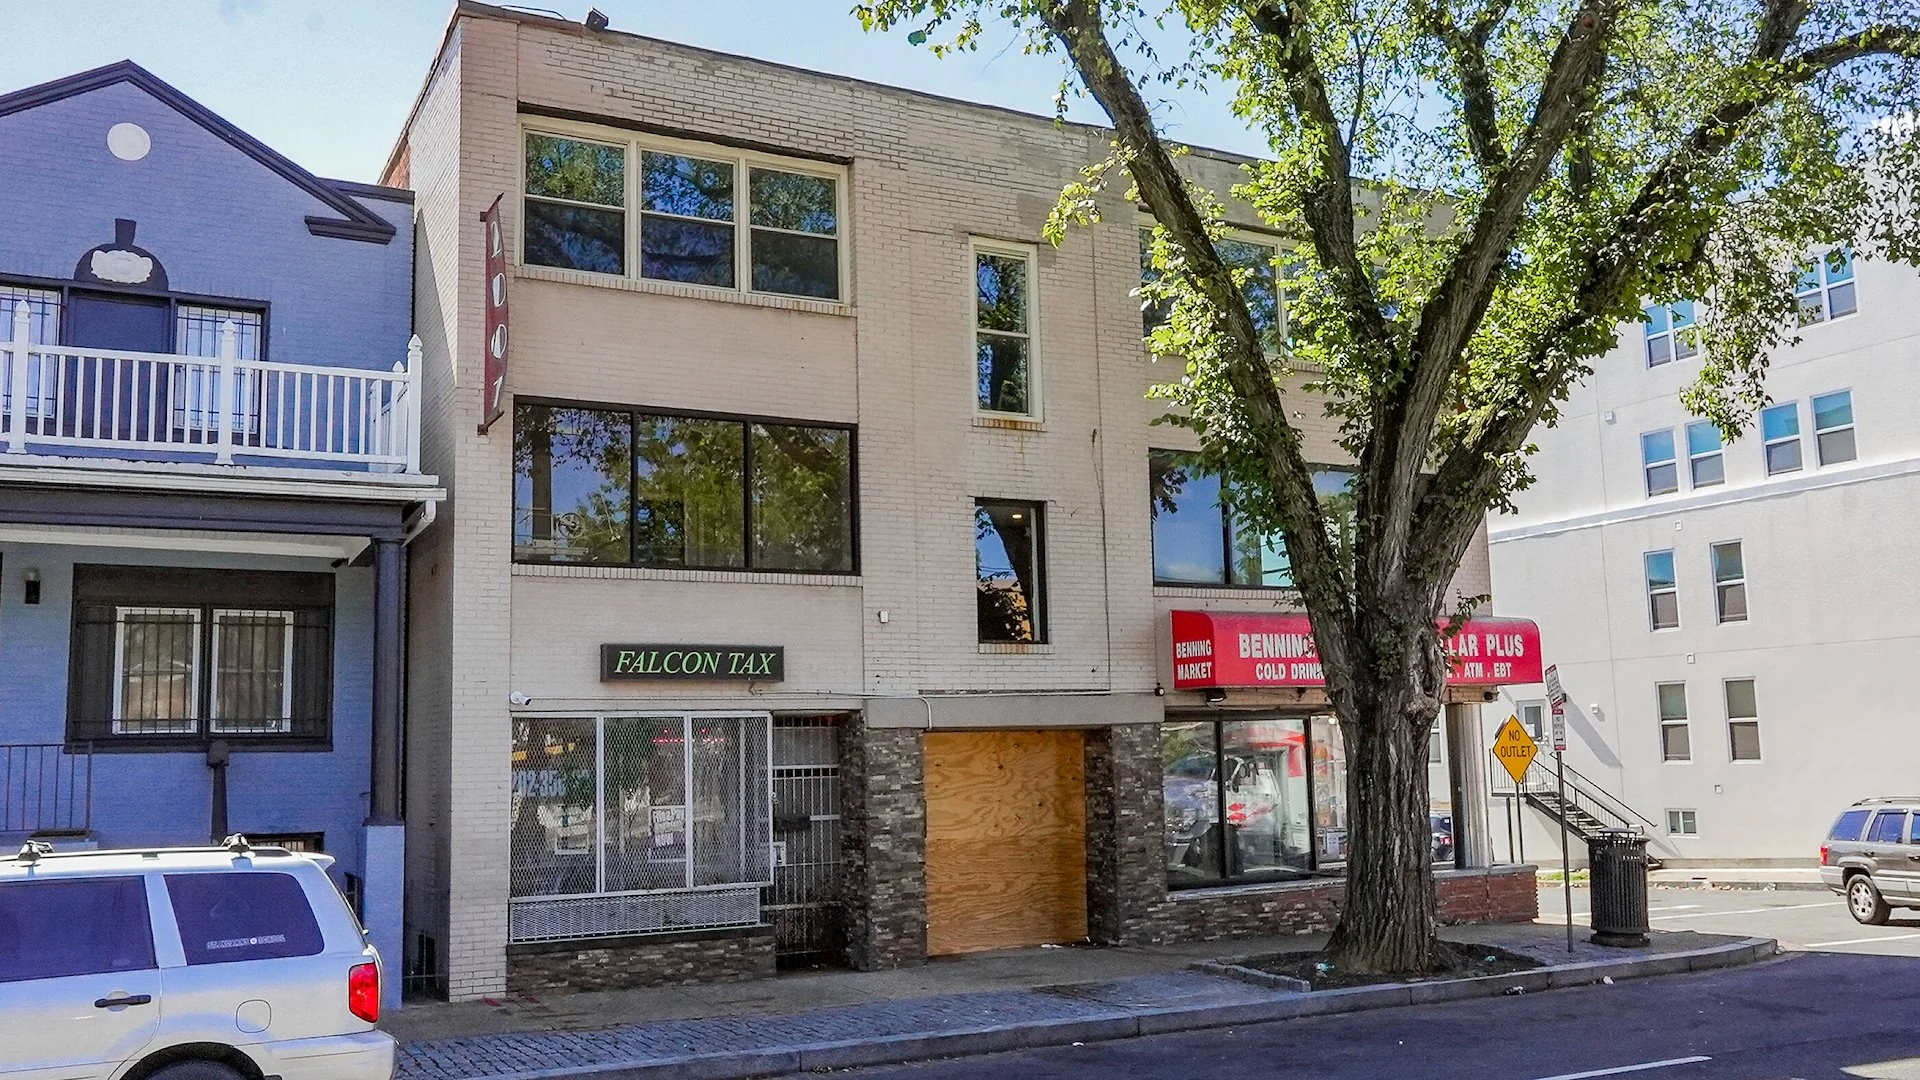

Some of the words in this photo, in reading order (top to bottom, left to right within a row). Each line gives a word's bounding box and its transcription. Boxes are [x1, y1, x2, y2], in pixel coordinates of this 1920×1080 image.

[1176, 639, 1212, 659] BENNING
[1486, 634, 1524, 657] PLUS
[614, 650, 722, 674] FALCON
[728, 652, 776, 675] TAX
[1177, 662, 1212, 680] MARKET
[1255, 663, 1287, 680] COLD
[1464, 662, 1484, 678] ATM
[1493, 662, 1512, 678] EBT
[1508, 730, 1521, 742] NO
[1500, 745, 1531, 758] OUTLET
